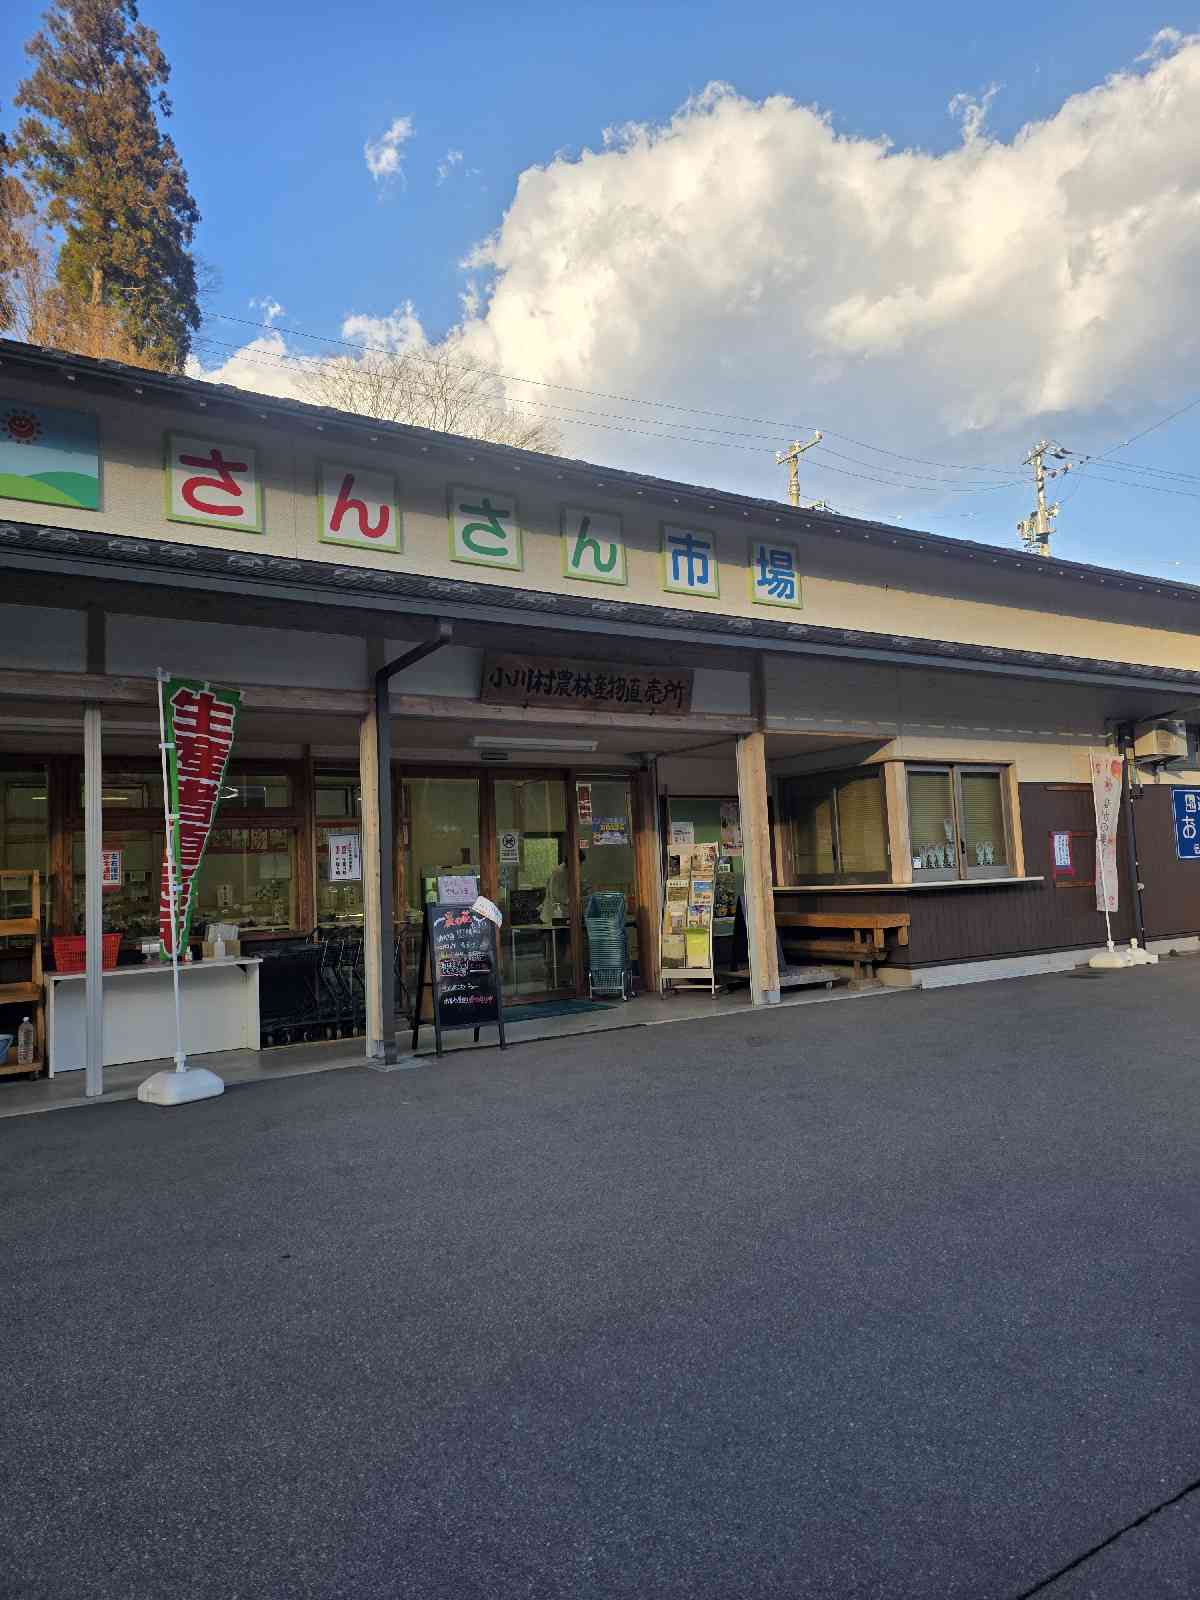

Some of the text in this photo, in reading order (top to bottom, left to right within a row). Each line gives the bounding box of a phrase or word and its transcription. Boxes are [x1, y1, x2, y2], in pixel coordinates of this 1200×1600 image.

[180, 448, 796, 601] さんさん市場
